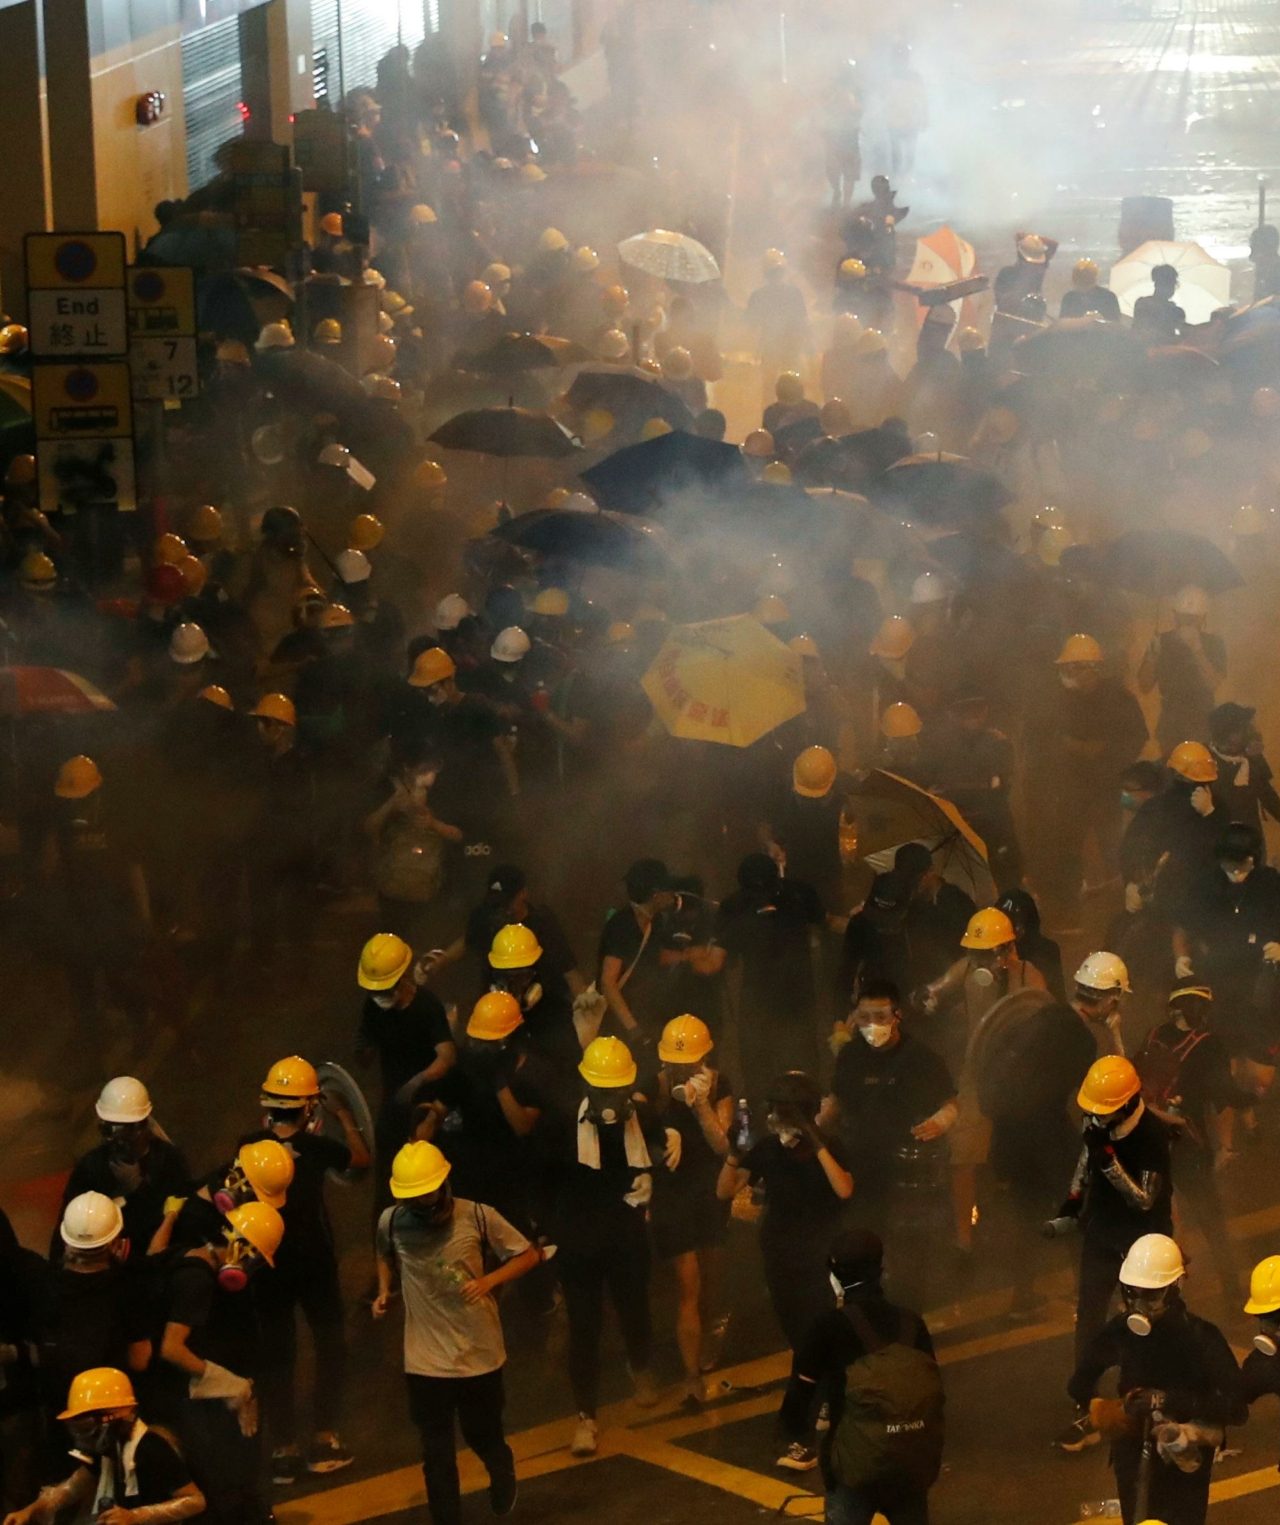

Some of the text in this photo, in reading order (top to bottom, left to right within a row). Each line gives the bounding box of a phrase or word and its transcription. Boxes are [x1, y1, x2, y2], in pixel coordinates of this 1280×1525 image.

[57, 298, 98, 315] End
[50, 324, 108, 347] 終止
[164, 341, 177, 360] 7
[167, 375, 192, 394] 12
